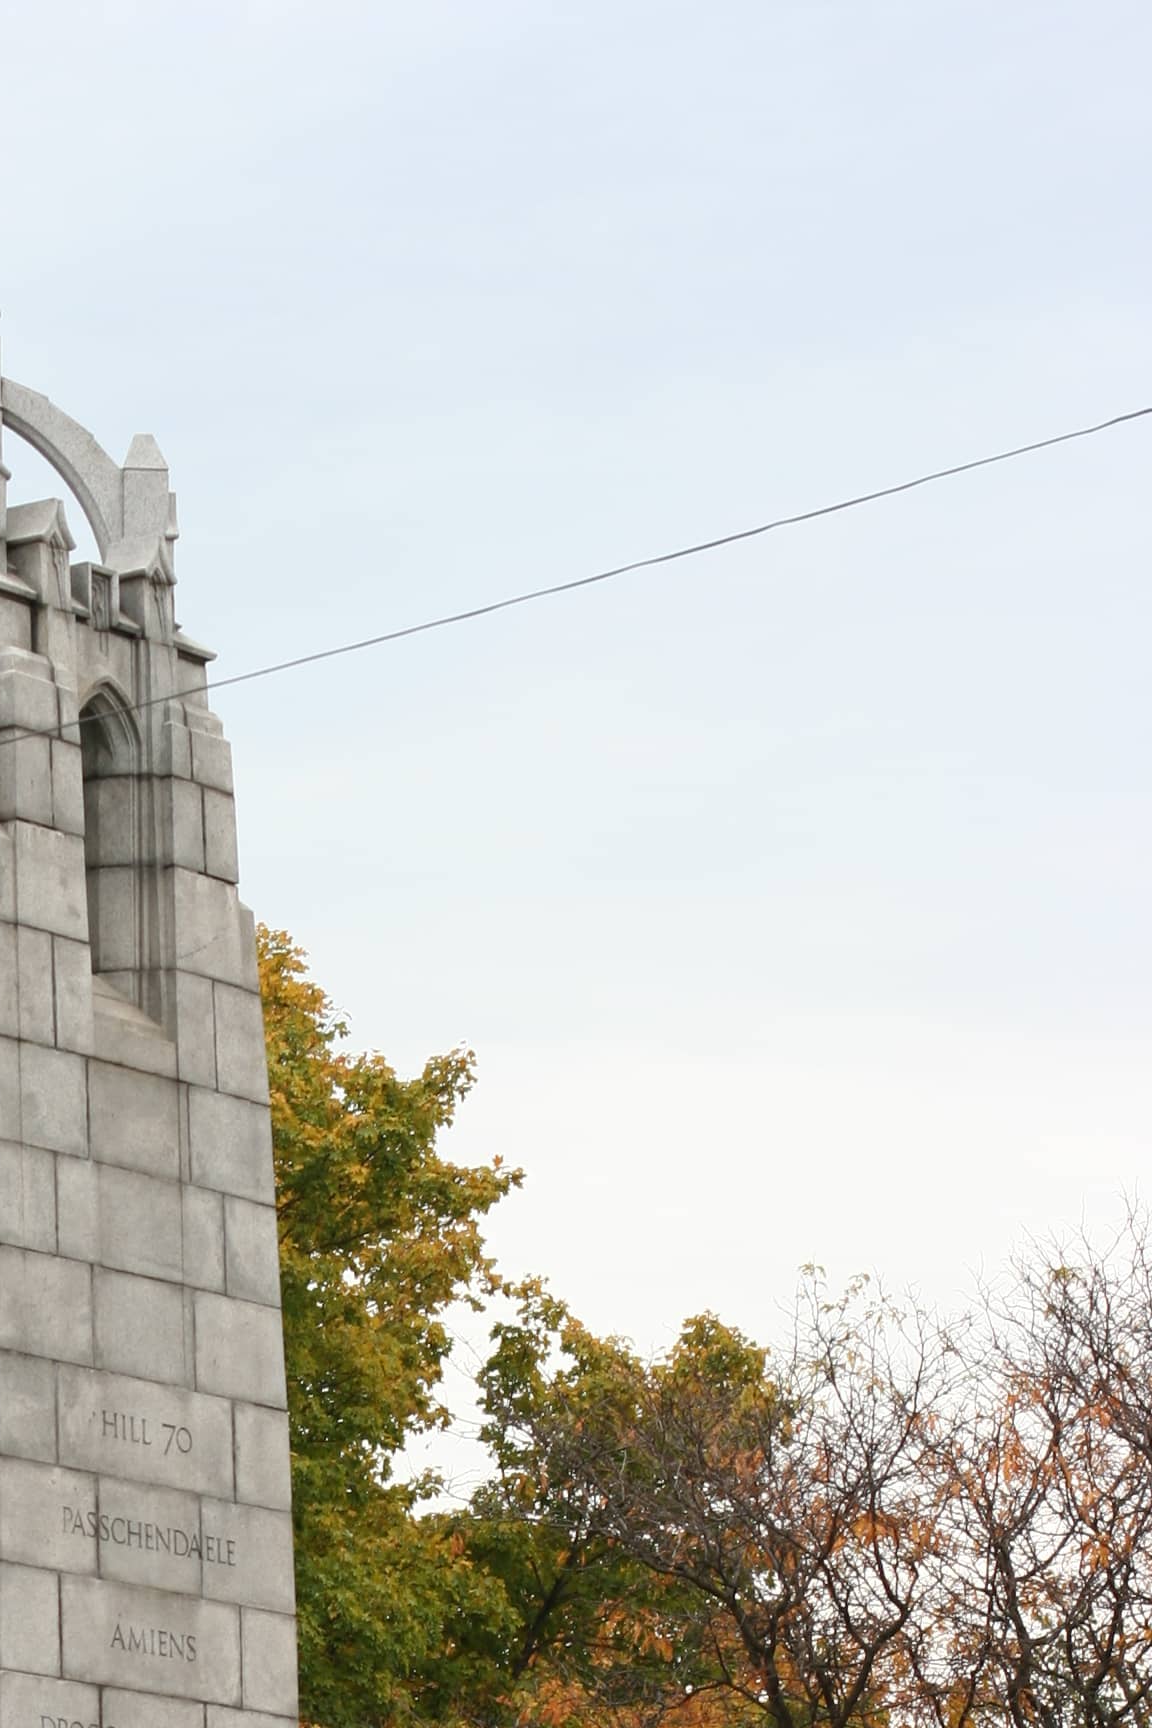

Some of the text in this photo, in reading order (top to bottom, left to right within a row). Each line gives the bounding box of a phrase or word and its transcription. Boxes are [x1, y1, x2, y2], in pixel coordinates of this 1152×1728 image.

[100, 1408, 194, 1457] HILL 70
[60, 1504, 237, 1568] PASSCHENDAELE
[109, 1623, 198, 1662] AMIENS
